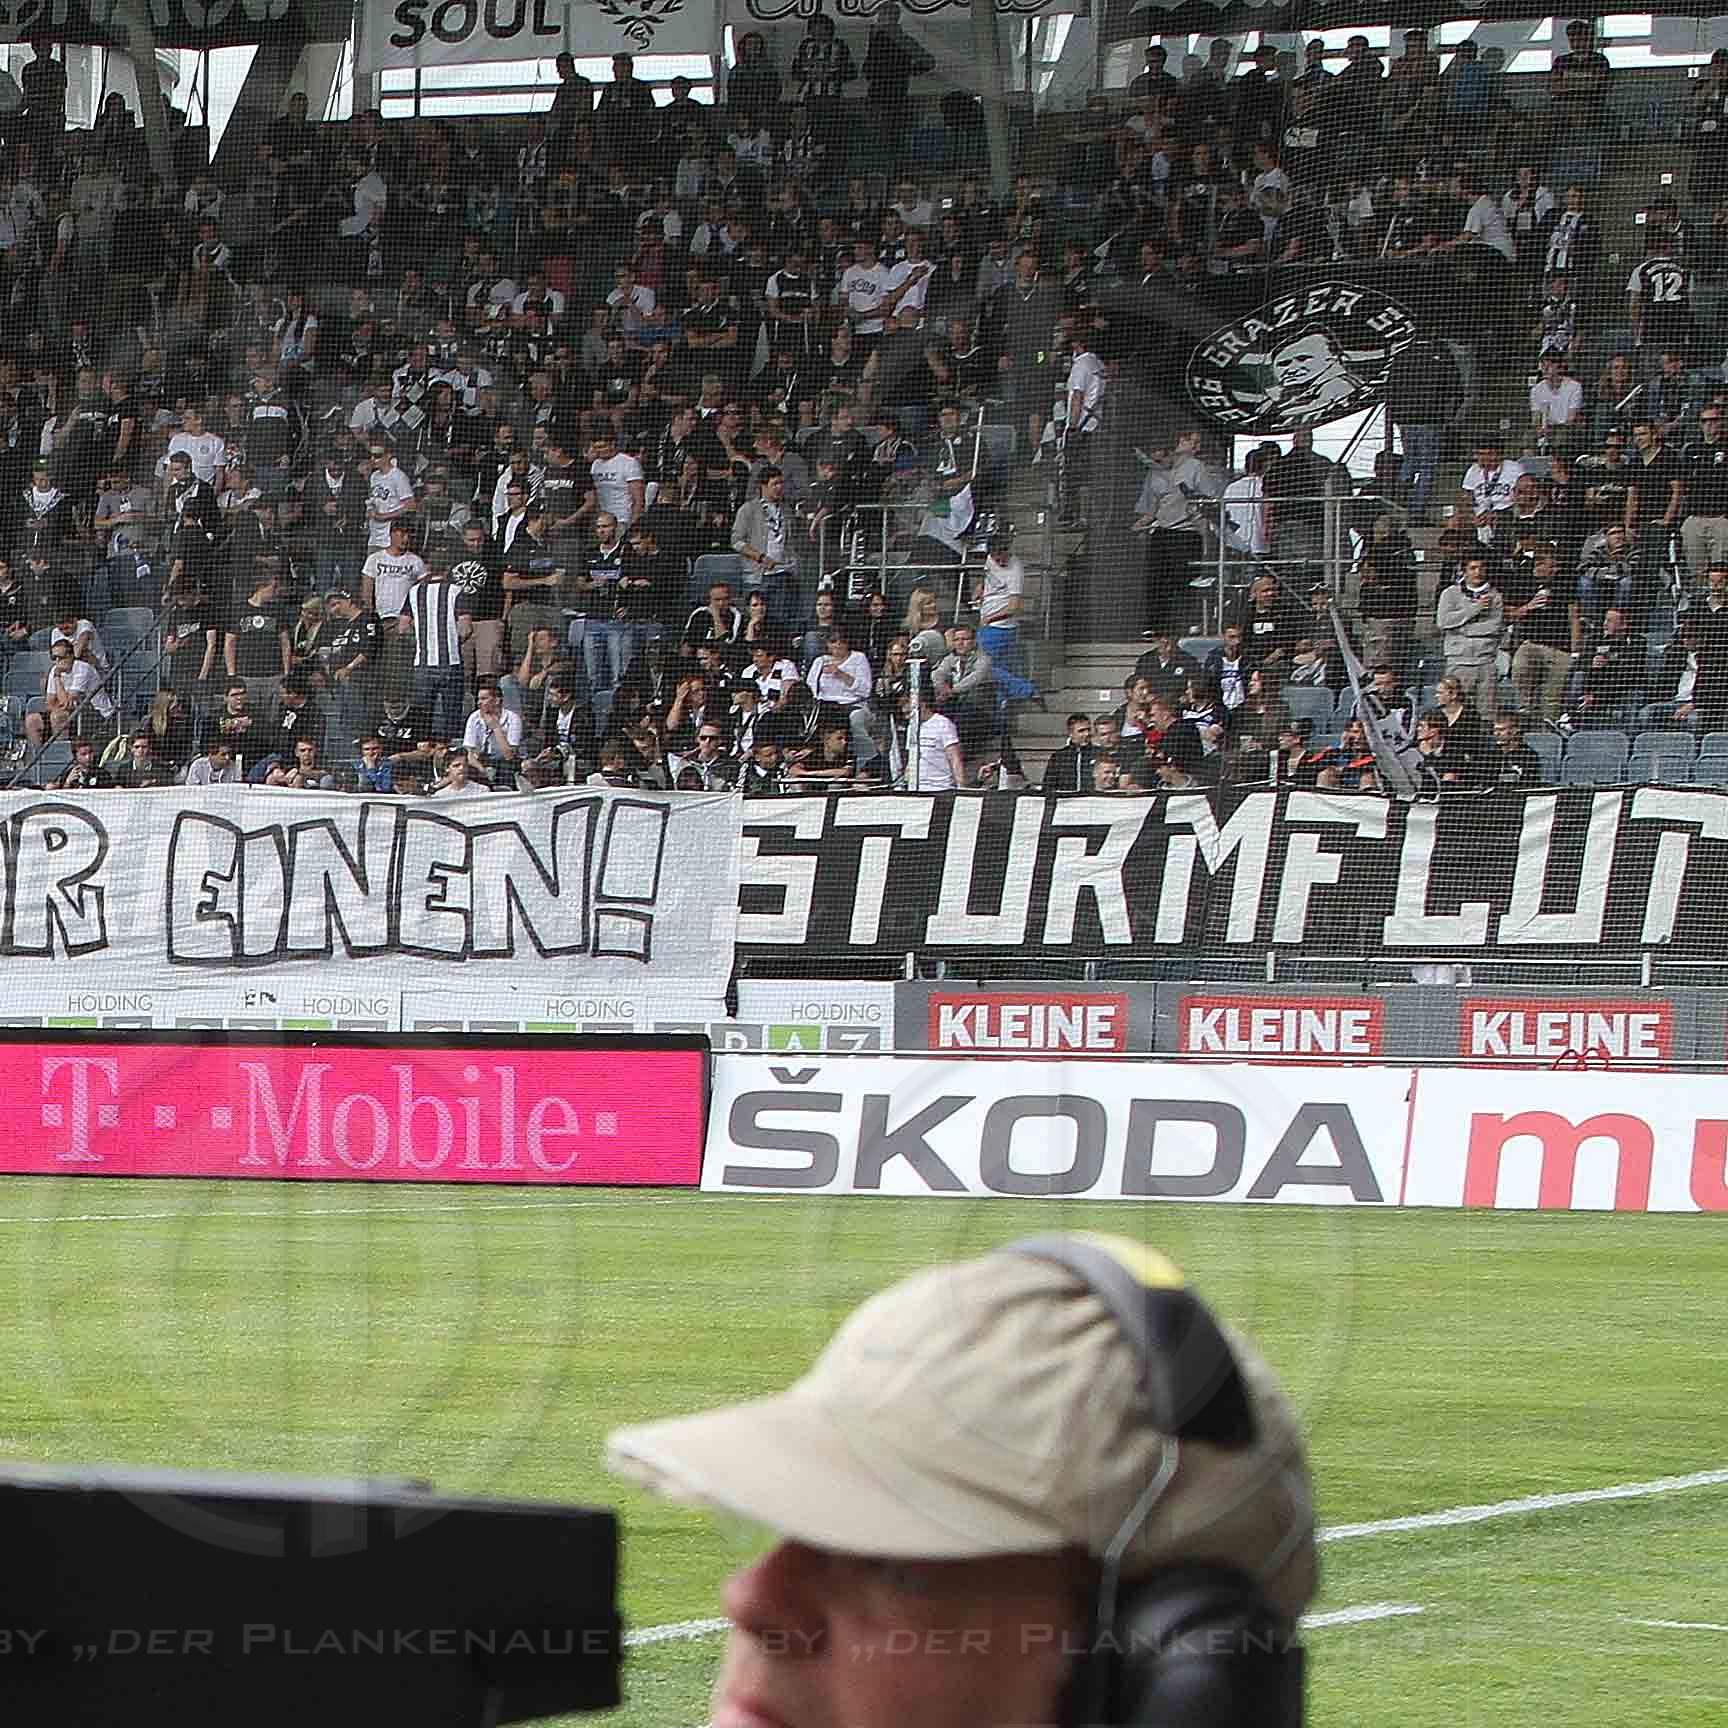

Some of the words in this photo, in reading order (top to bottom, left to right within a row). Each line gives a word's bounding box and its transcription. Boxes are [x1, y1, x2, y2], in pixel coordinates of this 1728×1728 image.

[391, 0, 563, 49] SOUL
[1650, 271, 1683, 303] 12
[735, 784, 1728, 949] STURMFLUT
[67, 994, 154, 1012] HOLDING
[302, 997, 390, 1016] HOLDING
[545, 999, 636, 1018] HOLDING
[790, 1003, 882, 1022] HOLDING
[938, 1002, 1114, 1050] KLEINE
[1187, 1006, 1373, 1053] KLEINE
[1471, 1008, 1662, 1058] KLEINE
[721, 1066, 1385, 1204] ŠKODA
